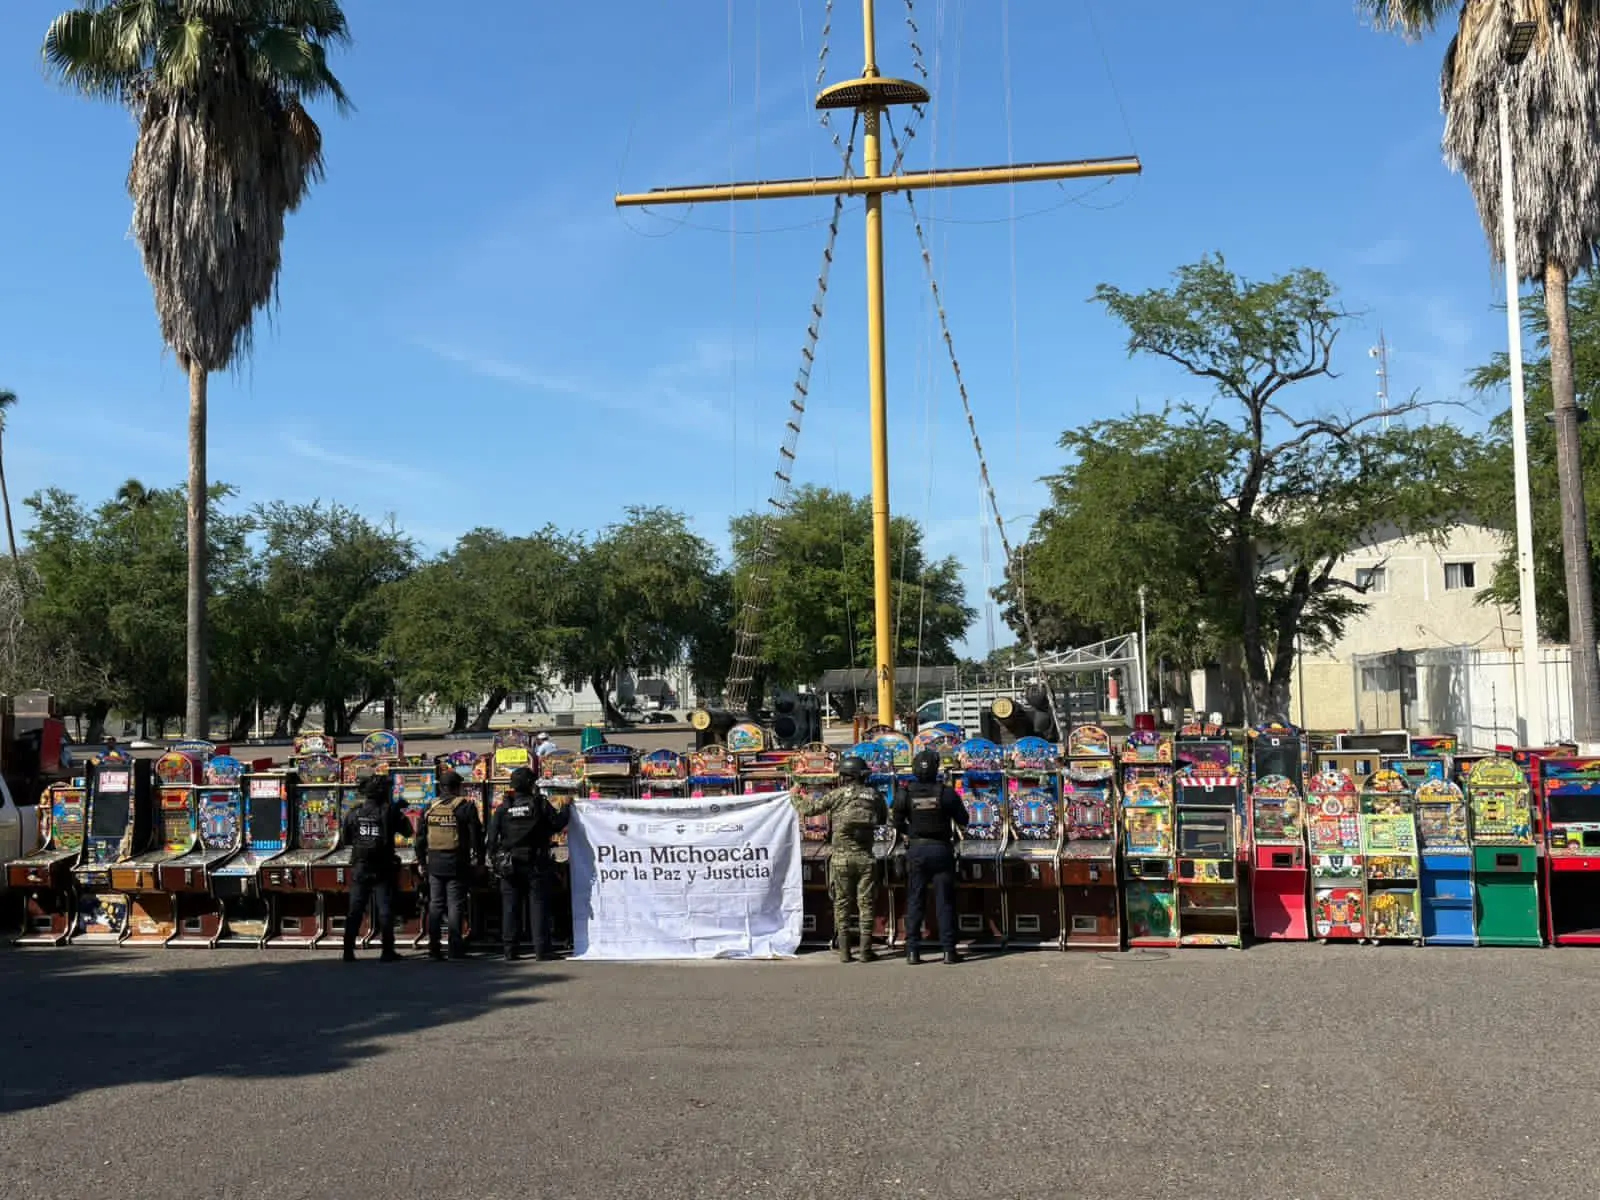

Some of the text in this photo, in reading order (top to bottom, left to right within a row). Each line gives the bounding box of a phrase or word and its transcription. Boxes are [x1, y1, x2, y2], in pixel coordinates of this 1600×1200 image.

[597, 842, 769, 863] Plan Michoacán
[600, 864, 770, 884] por la Paz y Justicia
